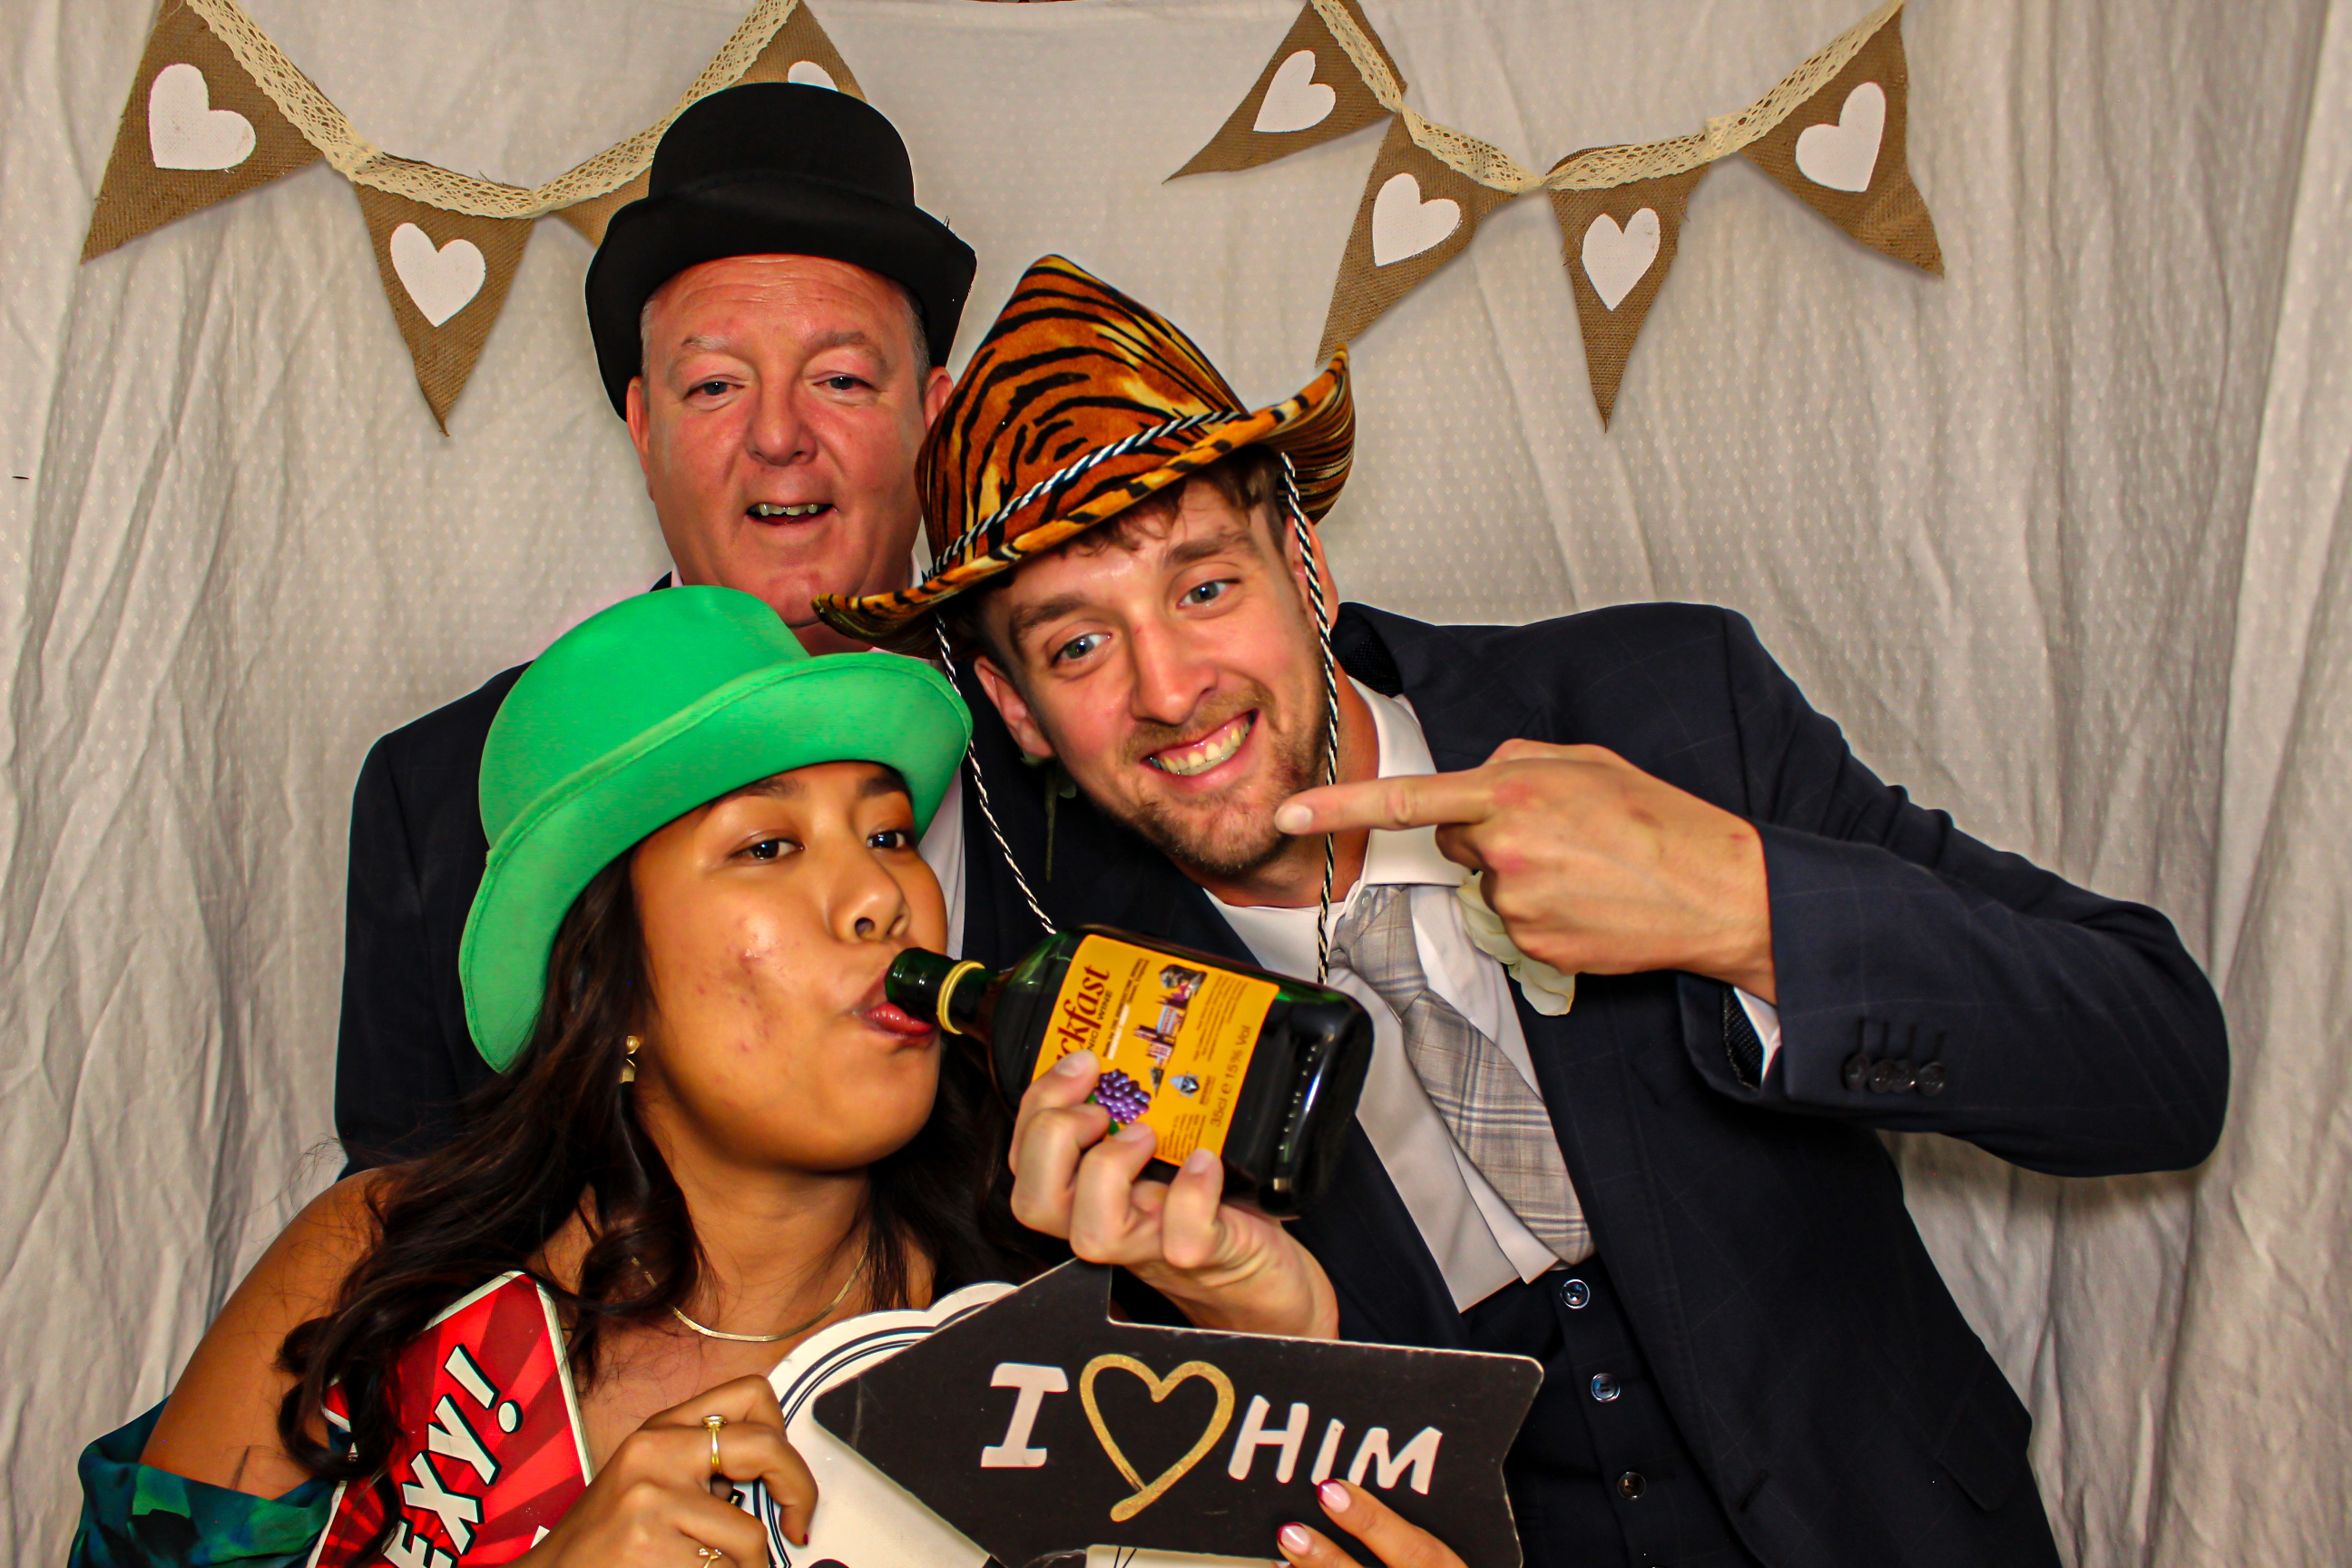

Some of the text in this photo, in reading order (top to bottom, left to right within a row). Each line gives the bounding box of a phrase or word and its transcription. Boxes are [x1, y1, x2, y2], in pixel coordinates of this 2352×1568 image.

[1055, 965, 1109, 1062] ckfast
[1096, 989, 1113, 1021] WINE
[1233, 1024, 1252, 1048] Vol
[1223, 1047, 1244, 1081] 15%
[1208, 1095, 1230, 1128] 35cl
[981, 1362, 1444, 1494] I HIM
